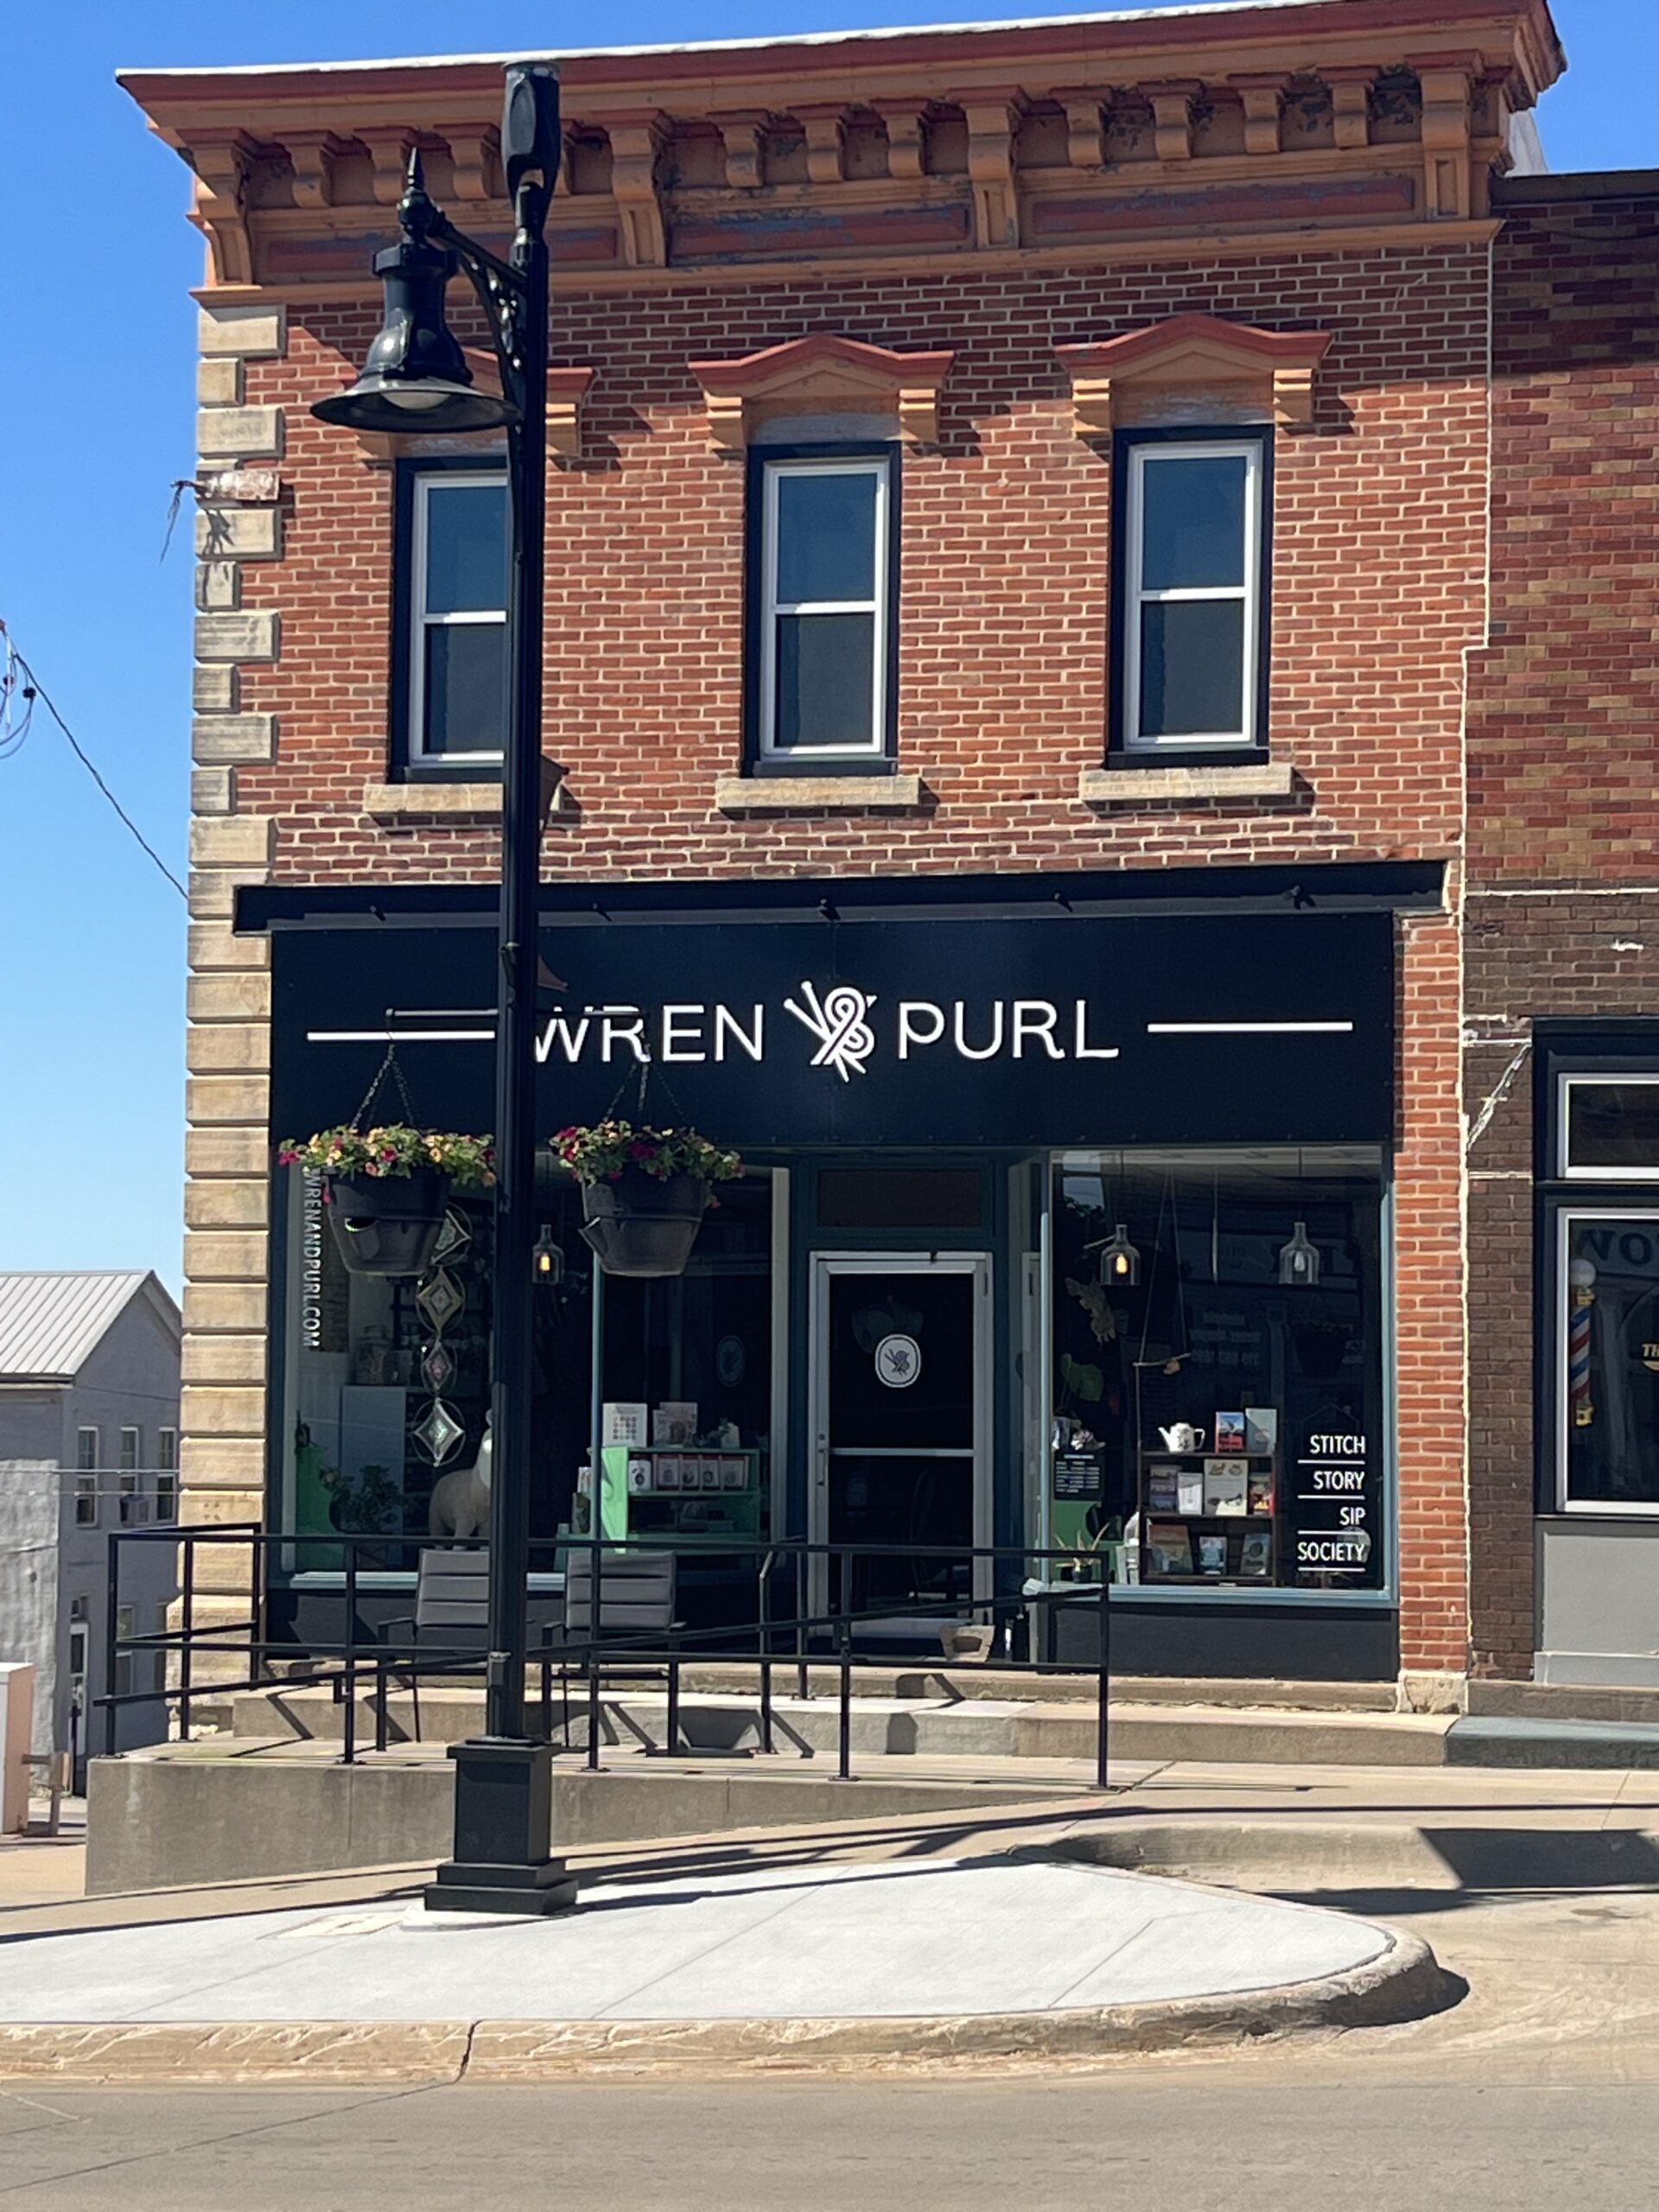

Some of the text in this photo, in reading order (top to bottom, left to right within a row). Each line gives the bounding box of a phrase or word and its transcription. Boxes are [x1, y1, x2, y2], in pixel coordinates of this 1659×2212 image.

[535, 1000, 1119, 1063] WREN PURL
[1309, 1434, 1366, 1455] STITCH
[1313, 1471, 1365, 1491] STORY
[1339, 1506, 1366, 1526] SIP
[1297, 1541, 1365, 1562] SOCIETY
